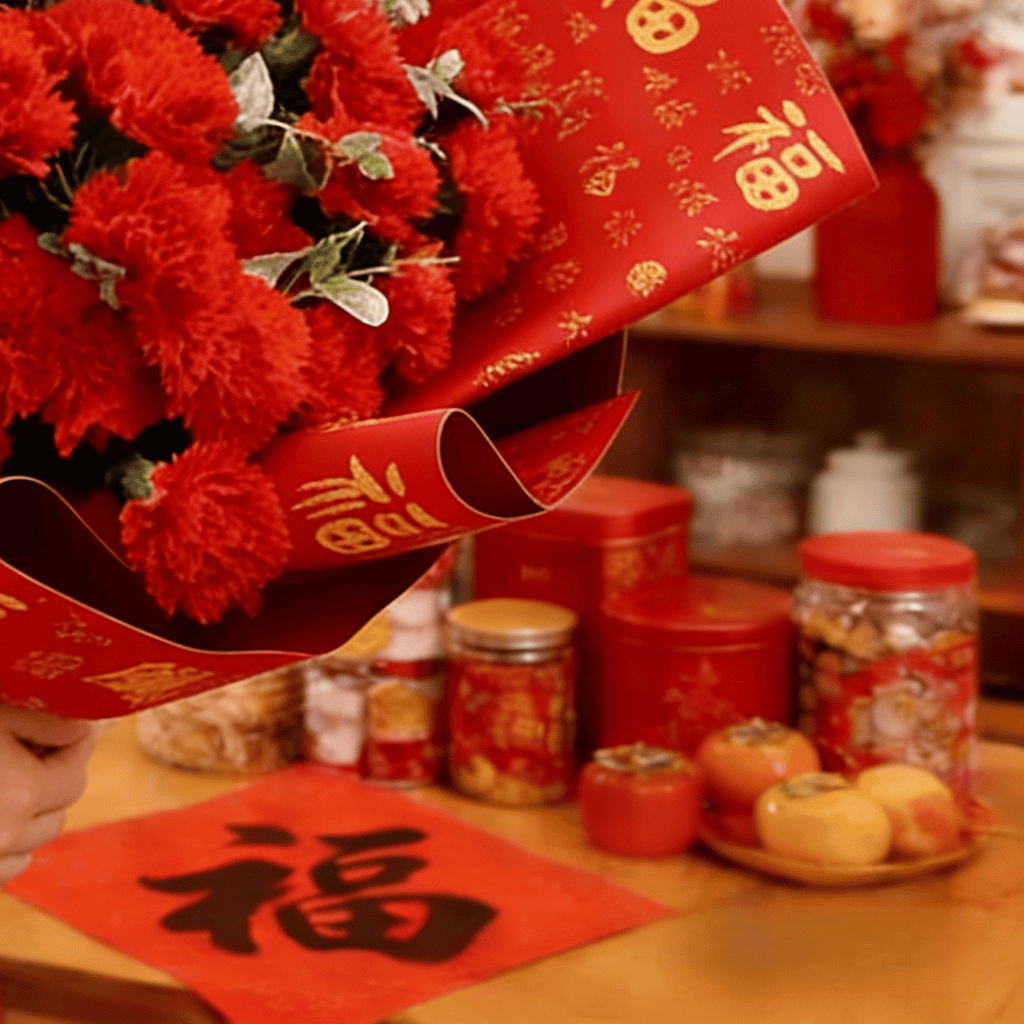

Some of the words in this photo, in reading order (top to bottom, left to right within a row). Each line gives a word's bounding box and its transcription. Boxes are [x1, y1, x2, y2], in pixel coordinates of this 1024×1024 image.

[713, 100, 845, 211] 福
[291, 454, 450, 554] 福
[136, 823, 499, 966] 福
